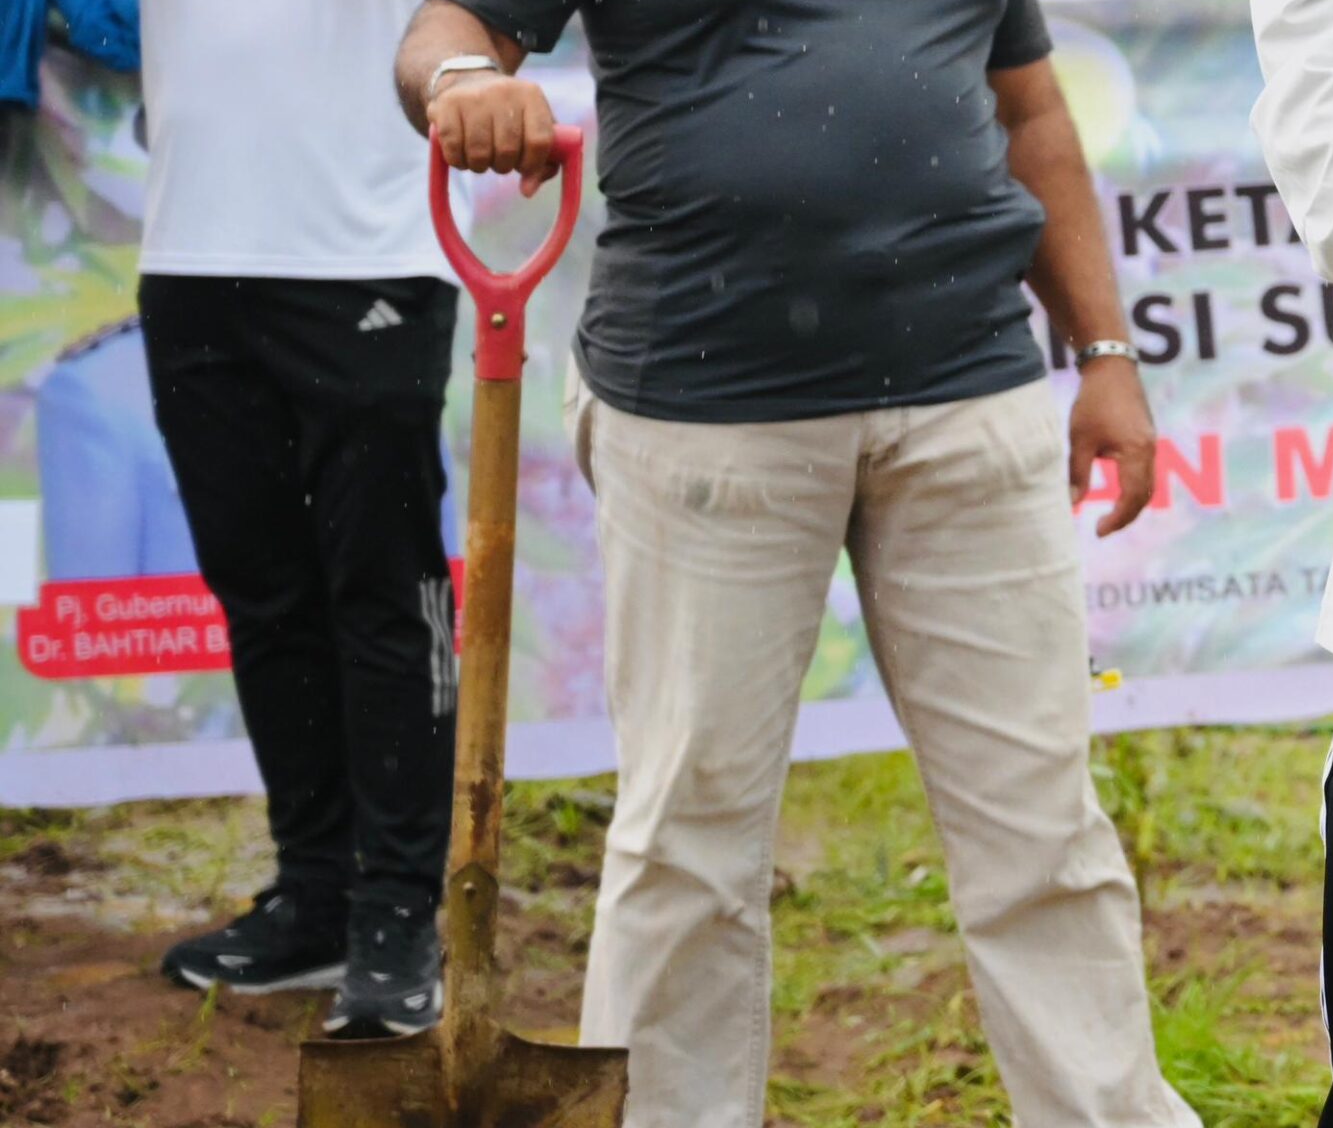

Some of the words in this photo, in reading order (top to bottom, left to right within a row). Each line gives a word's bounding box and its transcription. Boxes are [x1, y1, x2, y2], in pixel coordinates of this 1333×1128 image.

[1118, 184, 1305, 257] KET
[55, 595, 88, 629] Pj.
[29, 634, 67, 662] Dr.
[73, 626, 199, 660] BAHTIAR
